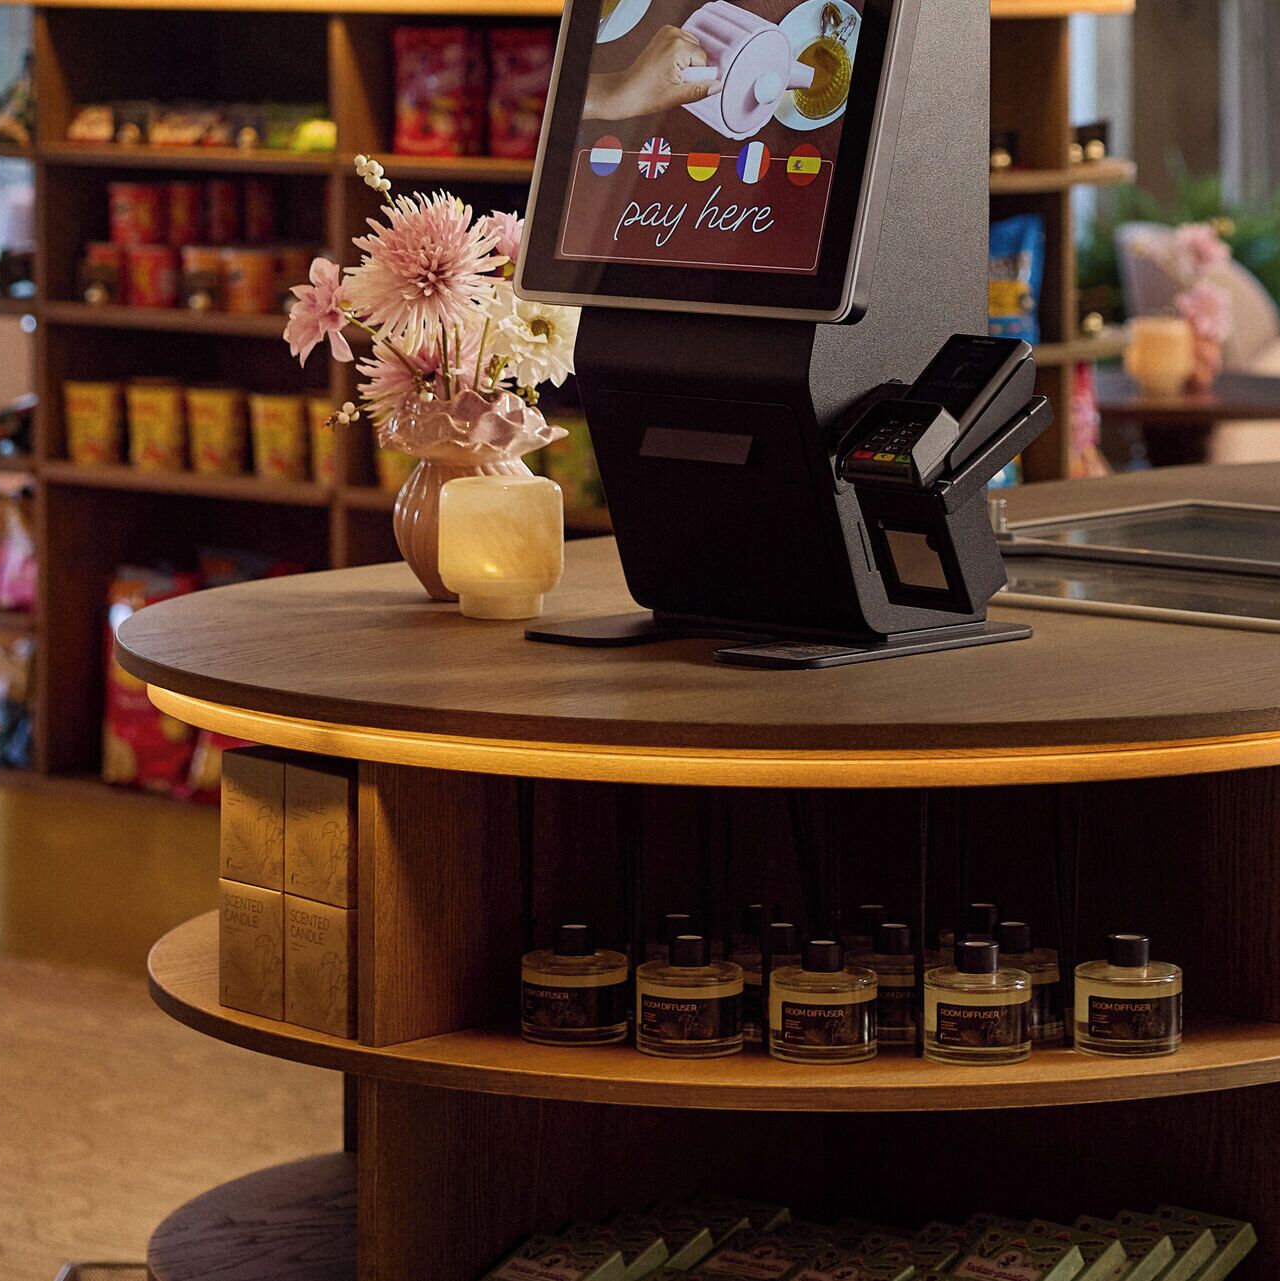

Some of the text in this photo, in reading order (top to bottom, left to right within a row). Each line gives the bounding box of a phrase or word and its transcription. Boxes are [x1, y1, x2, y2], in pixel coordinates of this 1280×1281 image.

[613, 185, 774, 247] pay here
[224, 893, 263, 914] SCENTED
[224, 908, 258, 929] CANDLE
[289, 909, 329, 931] SCENTED
[290, 925, 325, 946] CANDLE
[661, 1002, 697, 1012] DIFFUSER
[785, 1007, 844, 1018] ROOM DIFFUSER
[941, 1008, 1000, 1019] ROOM DIFFUSER
[1091, 1001, 1151, 1012] ROOM DIFFUSER
